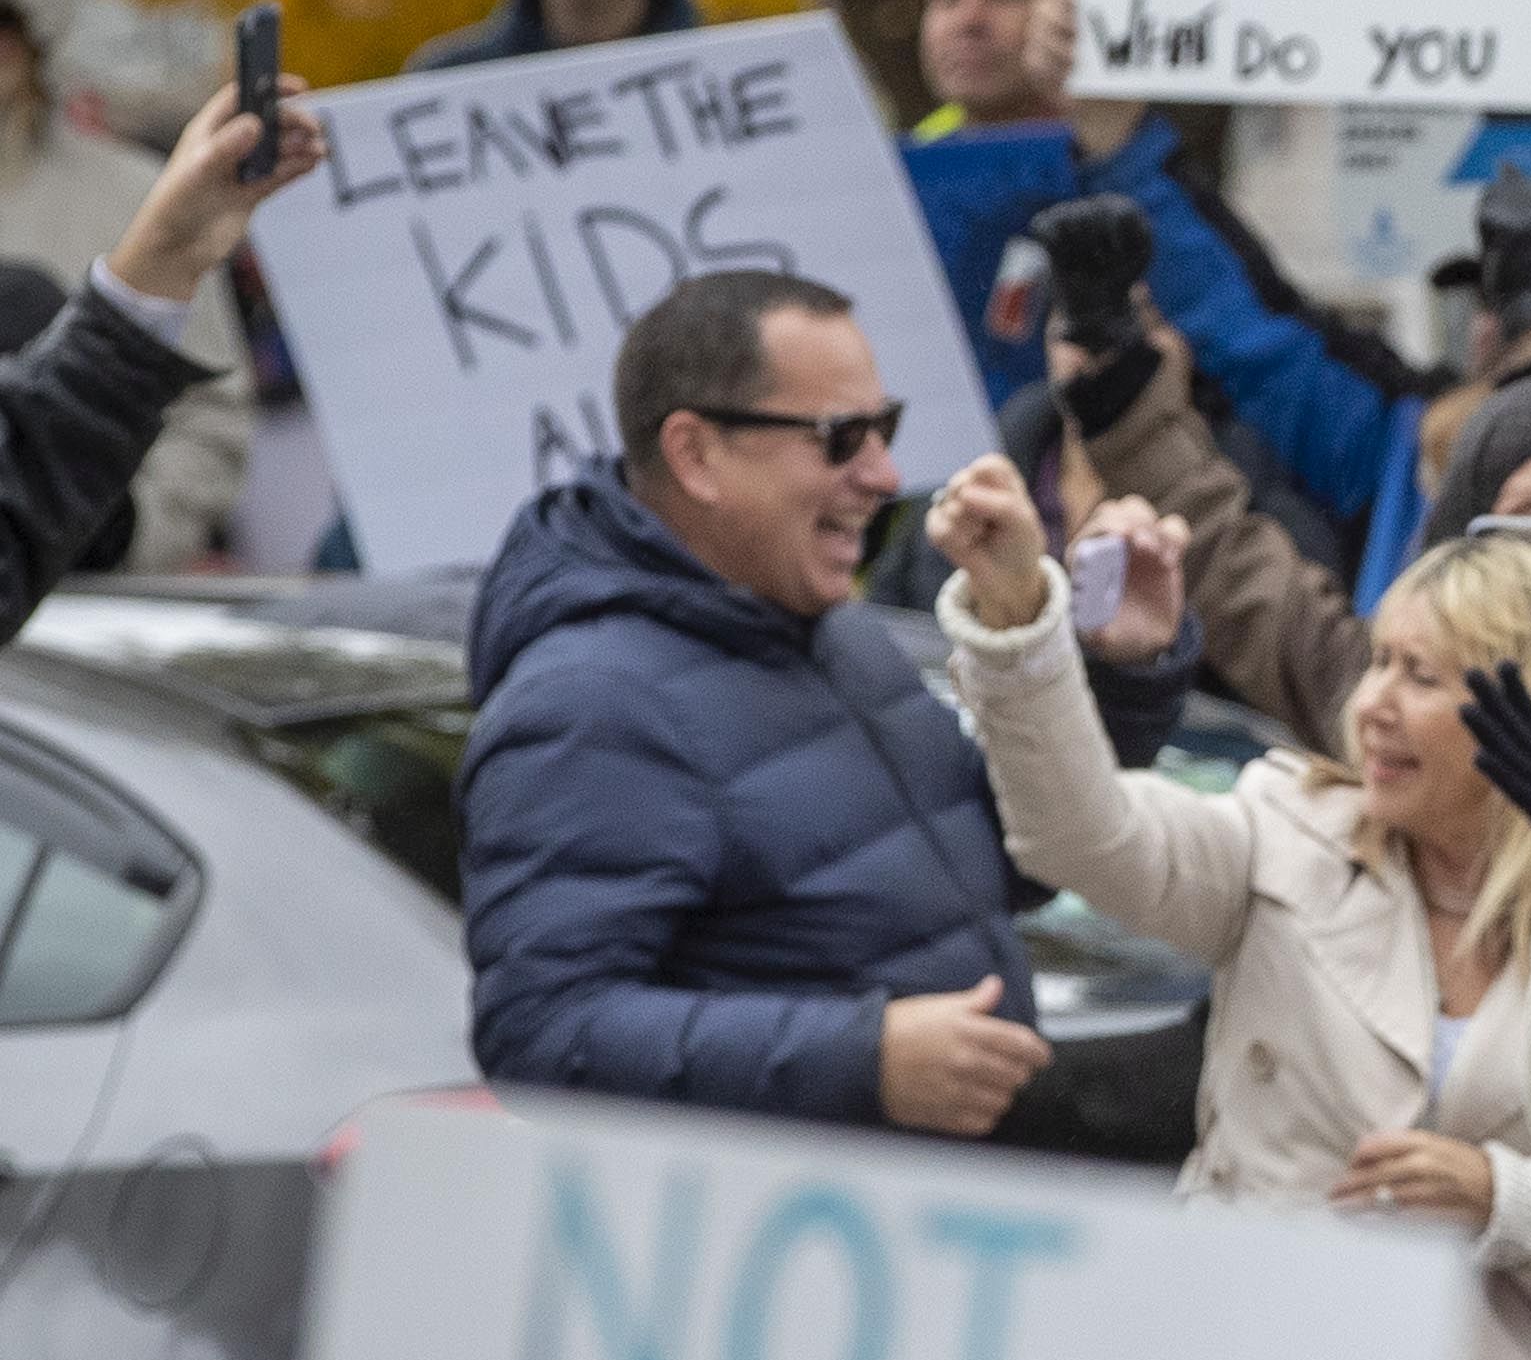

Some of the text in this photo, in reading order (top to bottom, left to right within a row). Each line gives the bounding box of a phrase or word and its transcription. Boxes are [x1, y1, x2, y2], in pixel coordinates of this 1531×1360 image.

[1232, 19, 1322, 85] DO
[1367, 23, 1499, 89] YOU
[318, 58, 806, 210] LEAVE THE
